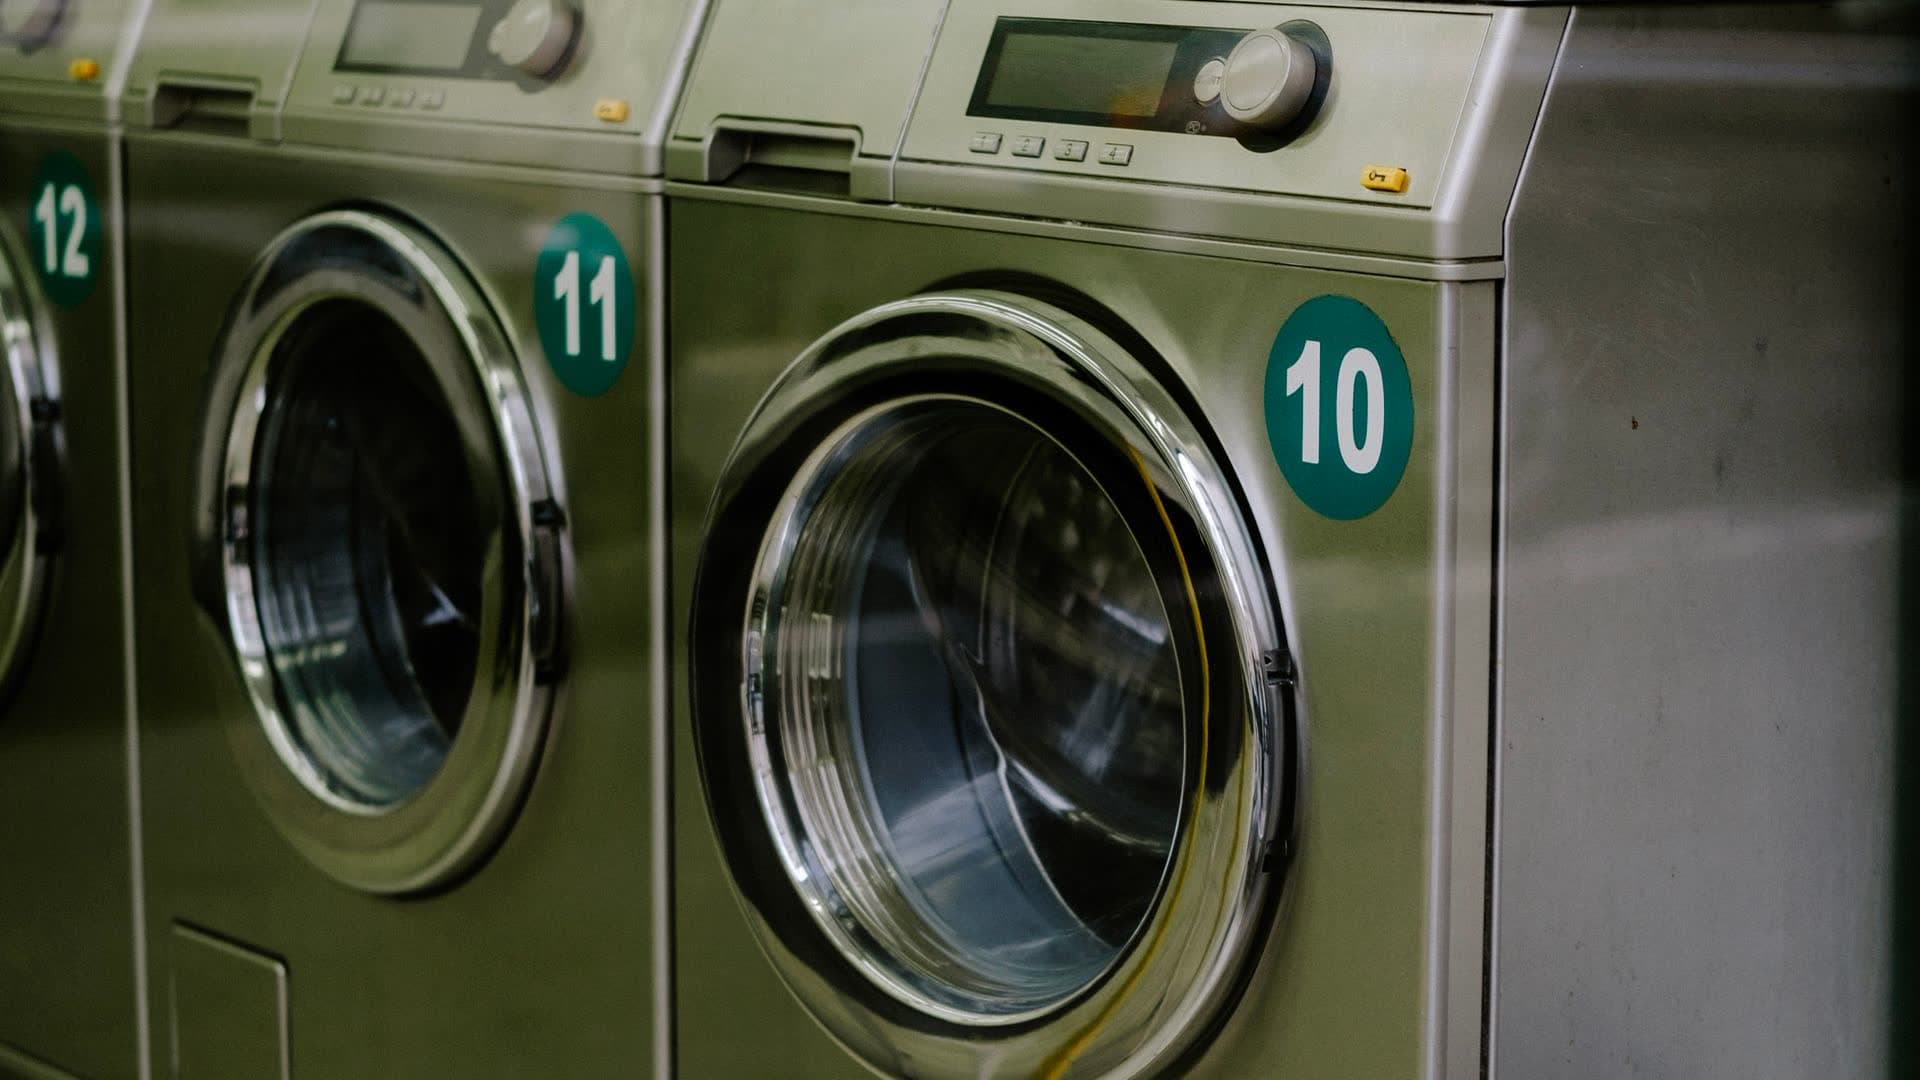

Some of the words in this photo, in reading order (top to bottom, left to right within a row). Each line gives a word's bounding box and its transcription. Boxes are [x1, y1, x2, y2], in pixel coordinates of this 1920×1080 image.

[1021, 138, 1031, 152] 2
[1064, 143, 1073, 157] 3
[1108, 146, 1118, 161] 4
[36, 184, 89, 277] 12
[554, 250, 617, 362] 11
[1284, 340, 1386, 475] 10
